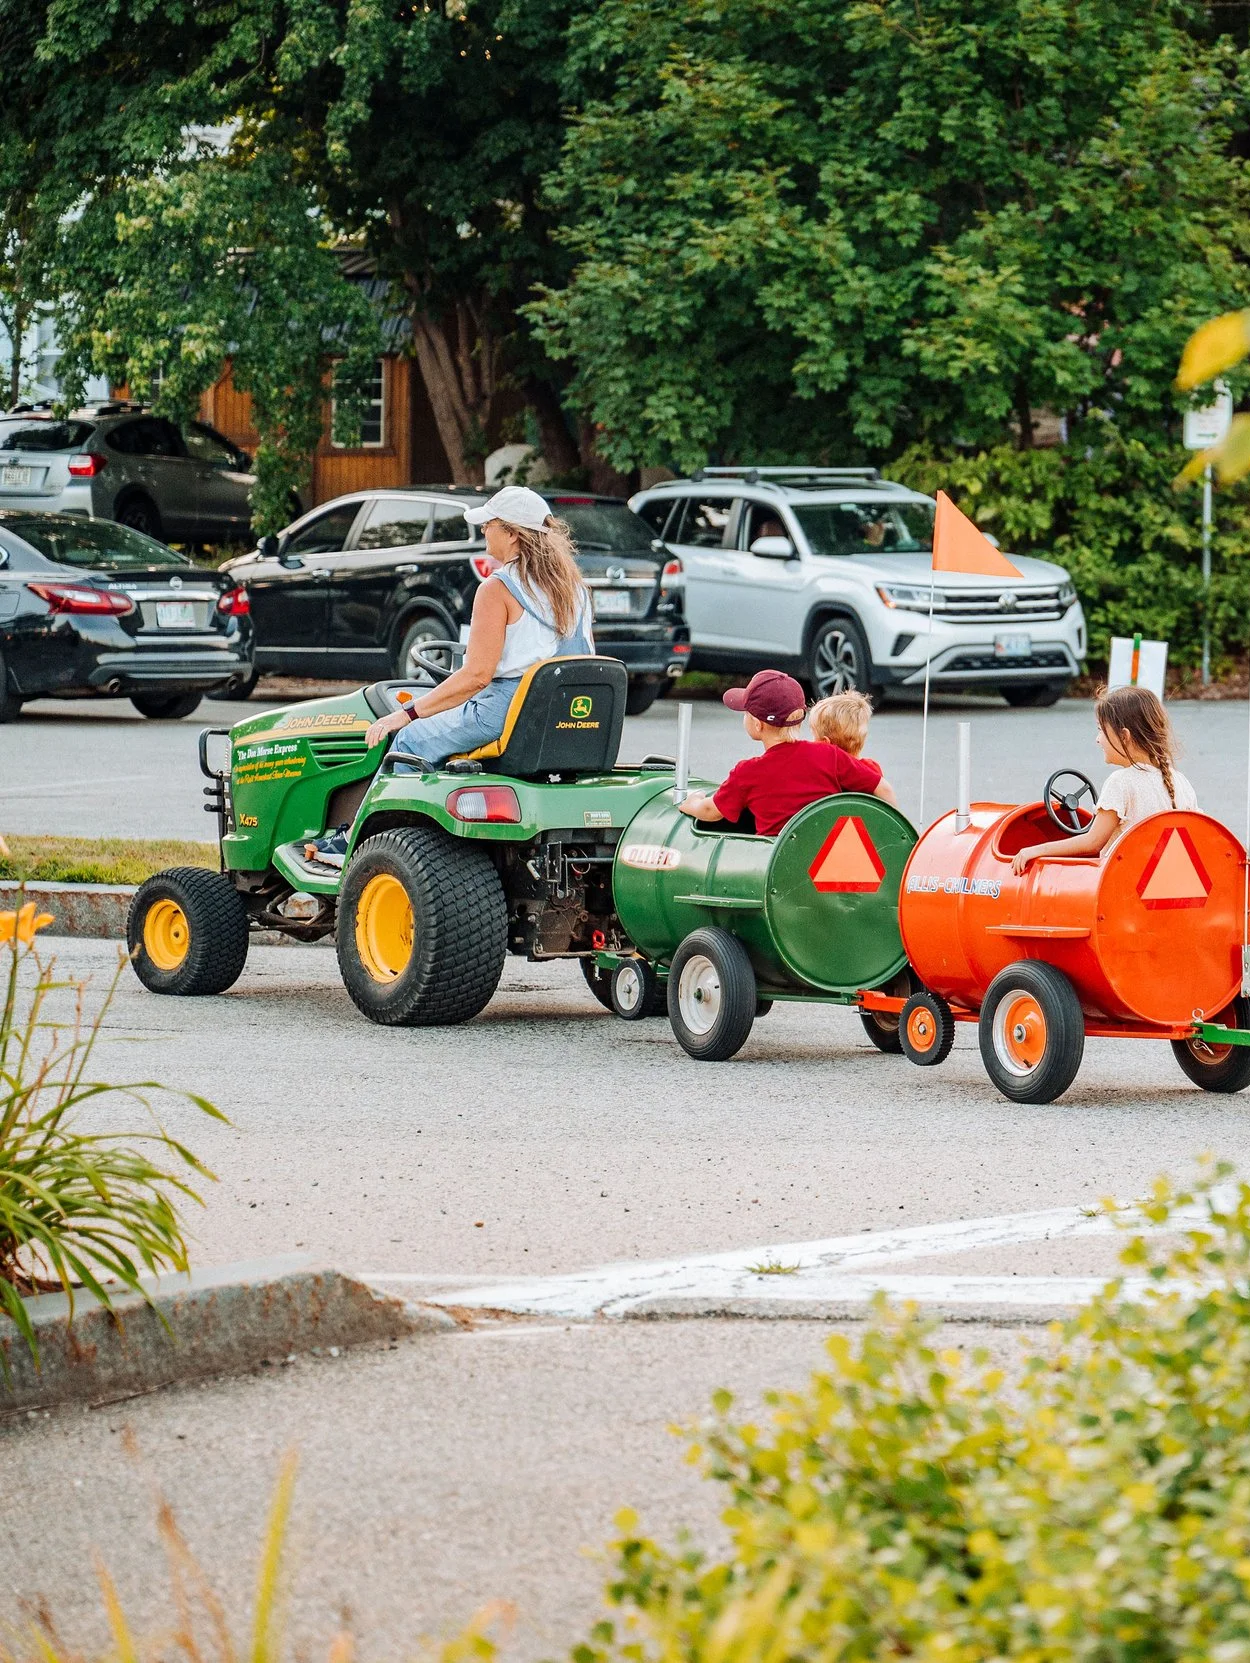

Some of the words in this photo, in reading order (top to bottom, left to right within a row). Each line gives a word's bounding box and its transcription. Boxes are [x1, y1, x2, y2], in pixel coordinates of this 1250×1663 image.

[283, 716, 314, 730] JOHN
[313, 713, 356, 727] DEERE
[555, 721, 577, 729] JOHN
[576, 721, 600, 729] DEERE
[239, 813, 259, 828] X475
